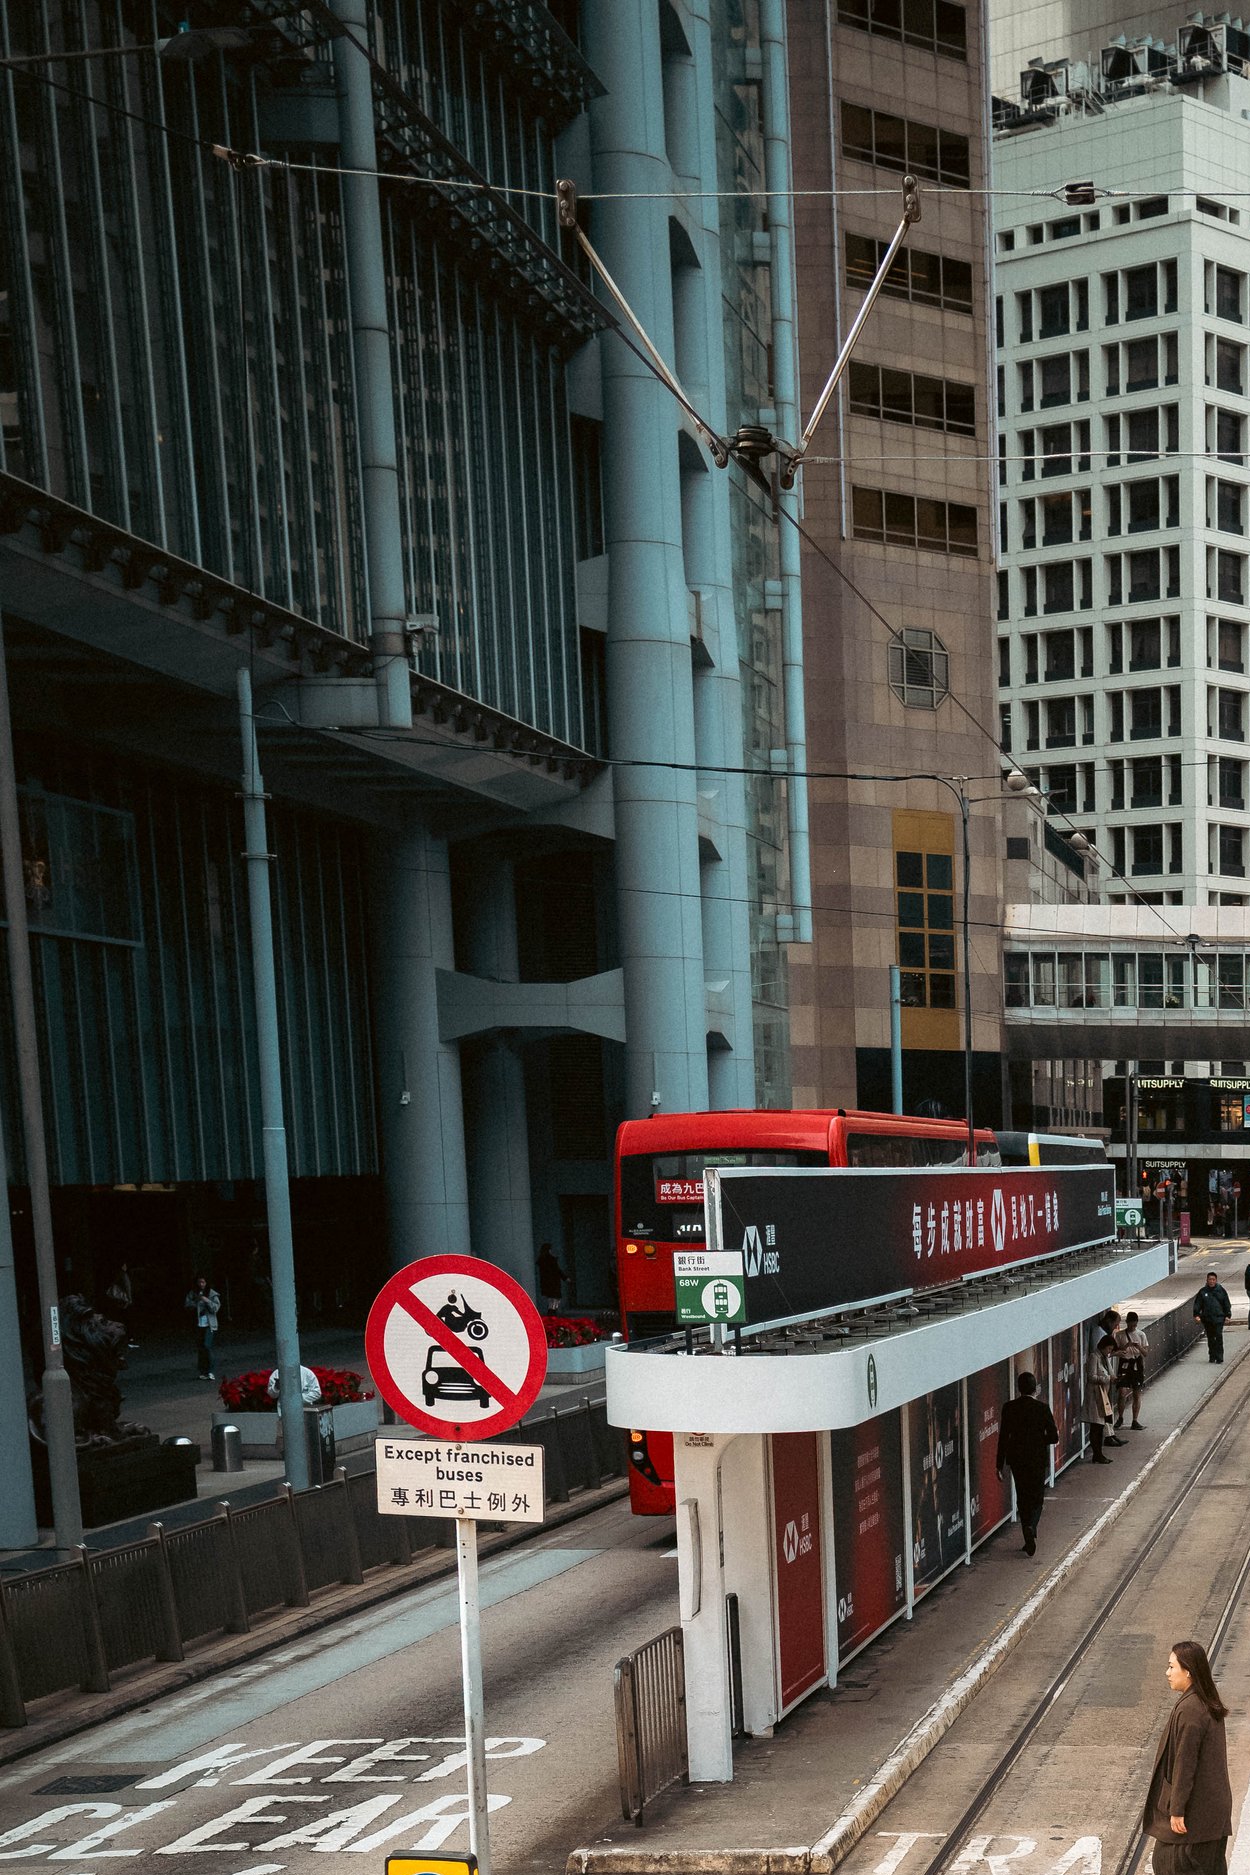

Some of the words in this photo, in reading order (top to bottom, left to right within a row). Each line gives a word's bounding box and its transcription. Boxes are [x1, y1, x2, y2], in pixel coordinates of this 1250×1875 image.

[1132, 1079, 1184, 1088] UITSUPPLY
[1145, 1160, 1187, 1168] SUITSUPPLY
[912, 1197, 985, 1260] 每步成就財富
[677, 1256, 705, 1265] 銀行街
[763, 1251, 780, 1275] HSBC
[679, 1279, 699, 1287] 68W
[384, 1446, 442, 1463] Except
[447, 1448, 535, 1467] franchised
[436, 1466, 484, 1483] buses
[390, 1487, 531, 1514] 專利巴士例外
[799, 1533, 813, 1556] HSBC
[134, 1738, 547, 1790] KEEP
[0, 1793, 513, 1860] CLEAR
